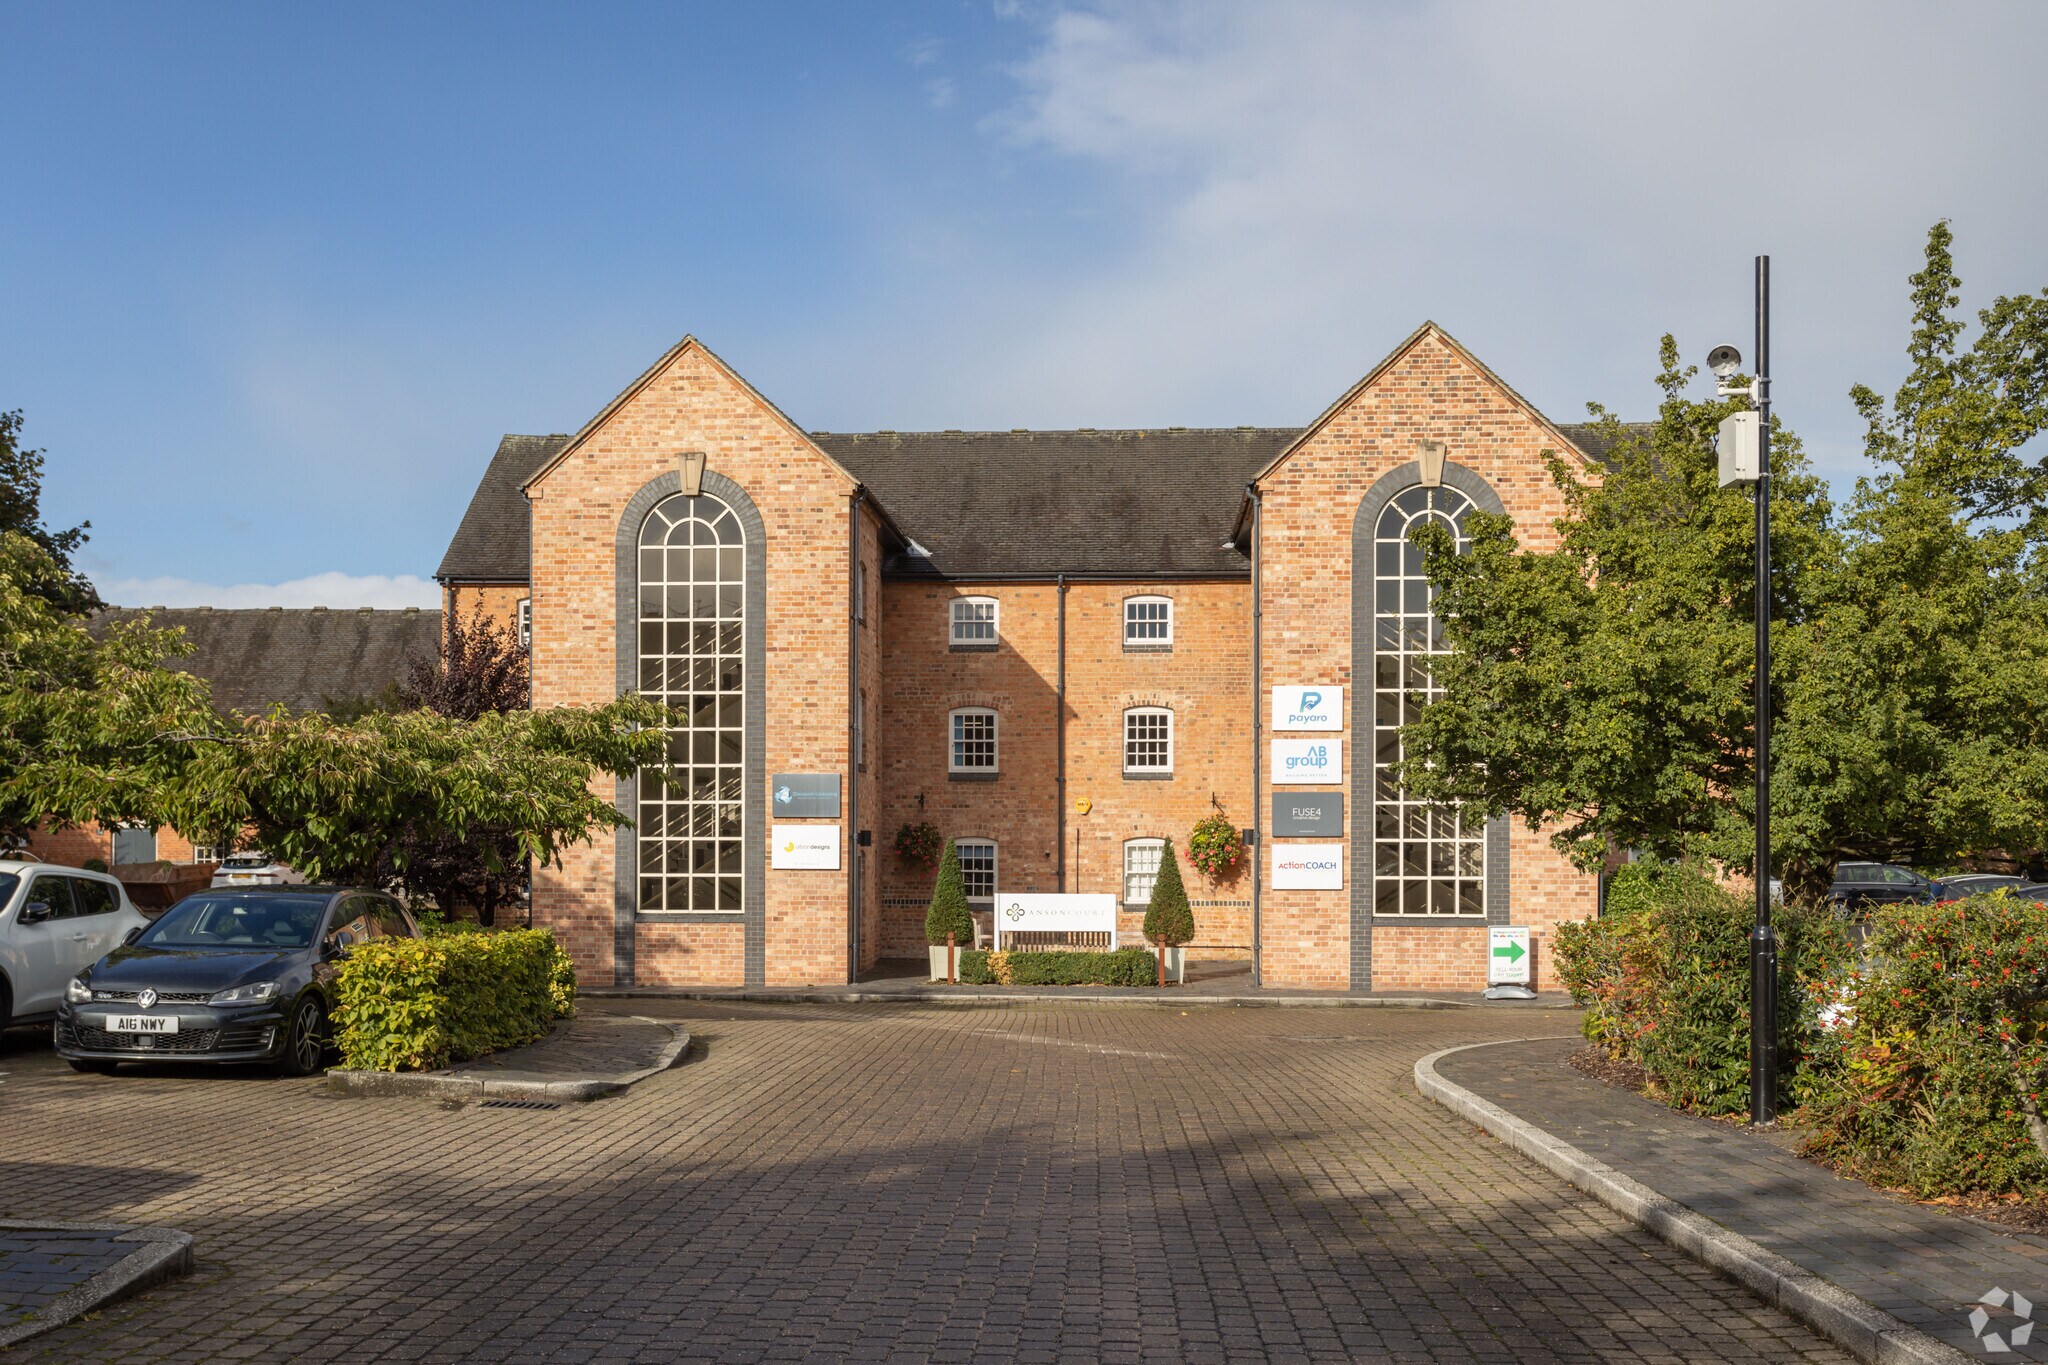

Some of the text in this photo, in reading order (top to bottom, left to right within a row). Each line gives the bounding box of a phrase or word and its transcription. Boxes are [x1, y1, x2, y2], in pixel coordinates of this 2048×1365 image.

[1288, 714, 1328, 725] payaro
[1286, 756, 1328, 769] group
[1292, 807, 1322, 816] FUSE4
[140, 1018, 166, 1031] NWY
